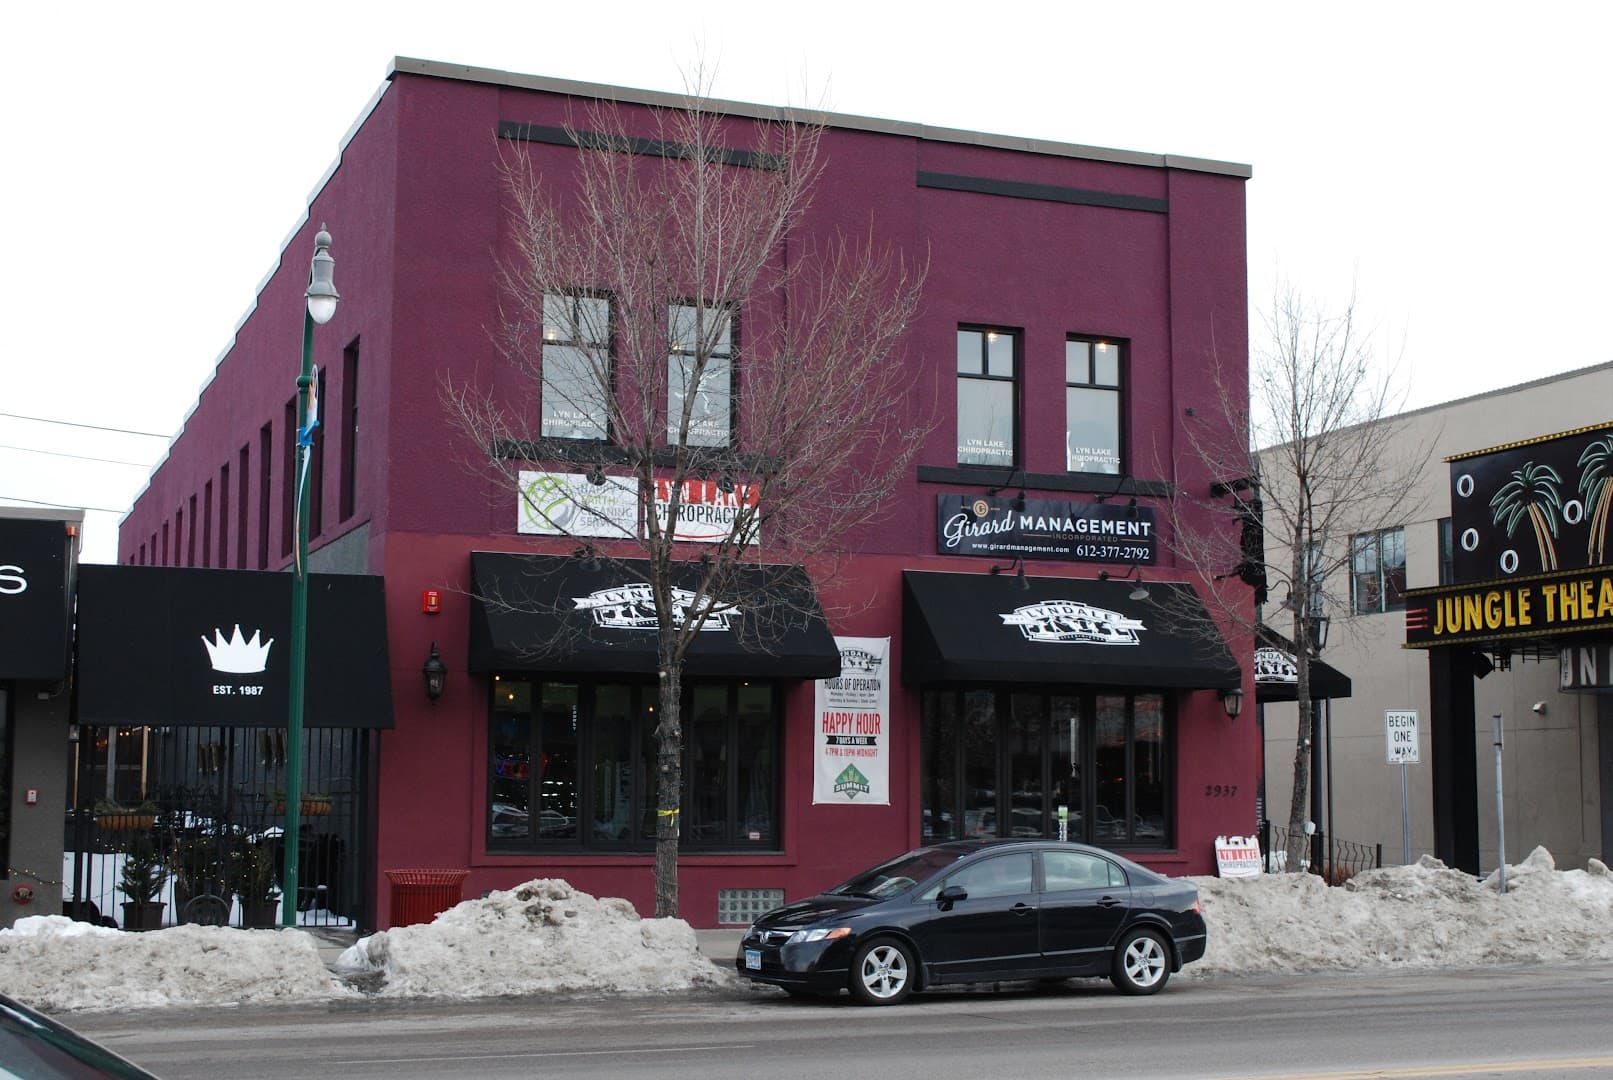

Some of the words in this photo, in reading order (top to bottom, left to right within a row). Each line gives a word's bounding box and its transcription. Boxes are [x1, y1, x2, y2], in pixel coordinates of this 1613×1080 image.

[967, 439, 981, 447] LYN
[984, 440, 1004, 448] LAKE
[957, 446, 1014, 457] CHIROPRACTIC
[1076, 447, 1090, 455] LYN
[1092, 448, 1112, 456] LAKE
[1071, 455, 1121, 464] HIROPRACTIC
[655, 503, 752, 524] CHROPRACTC
[943, 510, 1015, 547] Girard
[1020, 515, 1151, 536] MANAGEMENT
[1053, 534, 1118, 543] INCORPORATED
[971, 542, 1070, 553] www.girardmanagement.com
[1076, 544, 1150, 559] 612-377-2792
[1026, 606, 1114, 621] LYNDALE
[1433, 588, 1532, 635] JUNGLE
[212, 685, 236, 695] EST.
[239, 685, 264, 696] 1987
[823, 711, 853, 734] HAPPY
[856, 713, 881, 735] HOUR
[1388, 715, 1416, 728] BEGIN
[1393, 730, 1412, 742] ONE
[1394, 746, 1412, 755] WAY
[835, 781, 869, 793] SUMMIT
[1205, 785, 1237, 797] 2937
